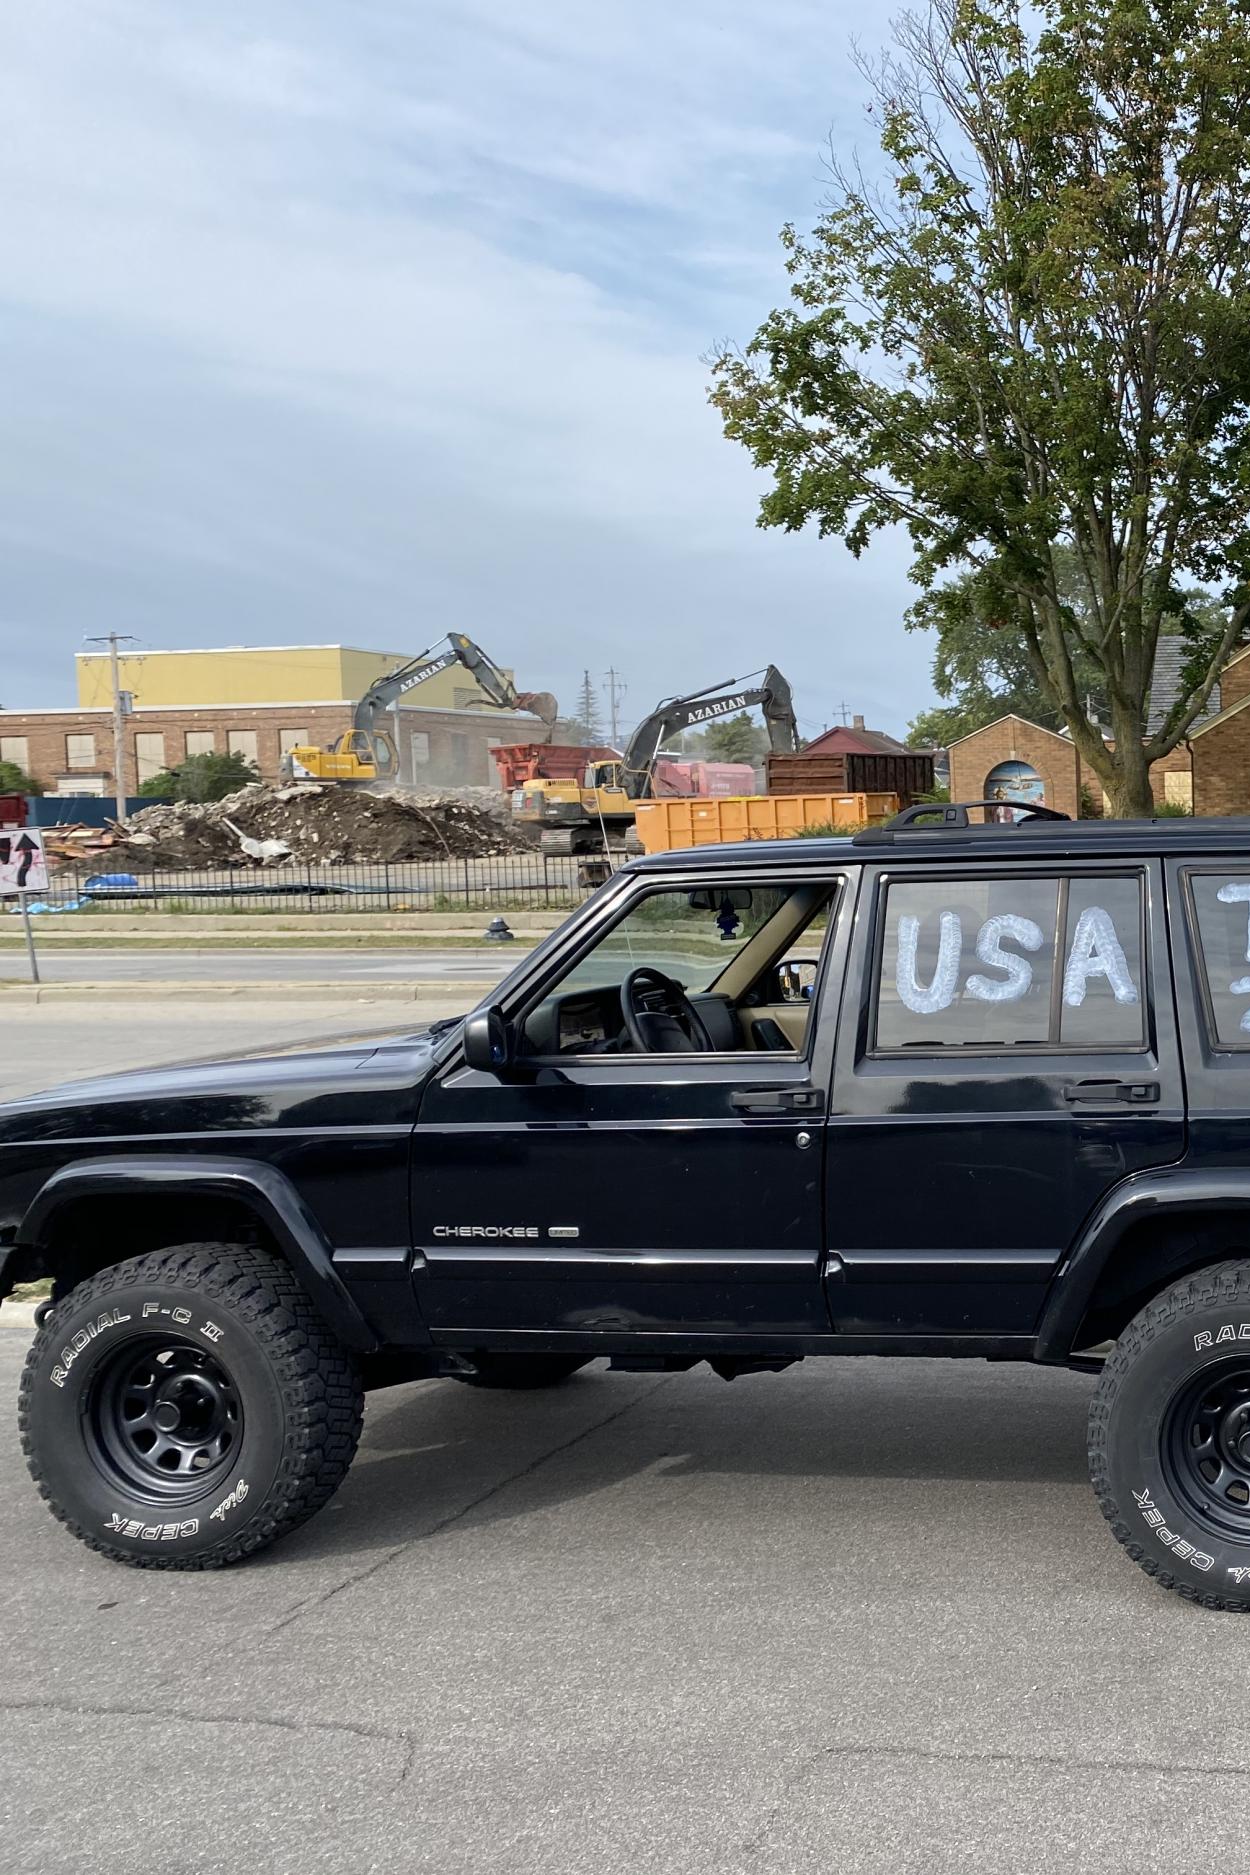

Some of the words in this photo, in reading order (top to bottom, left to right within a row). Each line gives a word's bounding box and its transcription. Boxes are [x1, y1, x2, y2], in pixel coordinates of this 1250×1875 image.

[399, 658, 447, 693] AZARIAN
[687, 695, 746, 724] AZARIAN
[895, 906, 1138, 1014] USA
[433, 1226, 539, 1238] CHEROKEE
[50, 1307, 131, 1388] RADIAL
[142, 1302, 192, 1324] F-C
[200, 1321, 225, 1343] II
[210, 1479, 250, 1522] Dick
[104, 1511, 200, 1541] CEPEK
[1131, 1487, 1215, 1573] CEPEK
